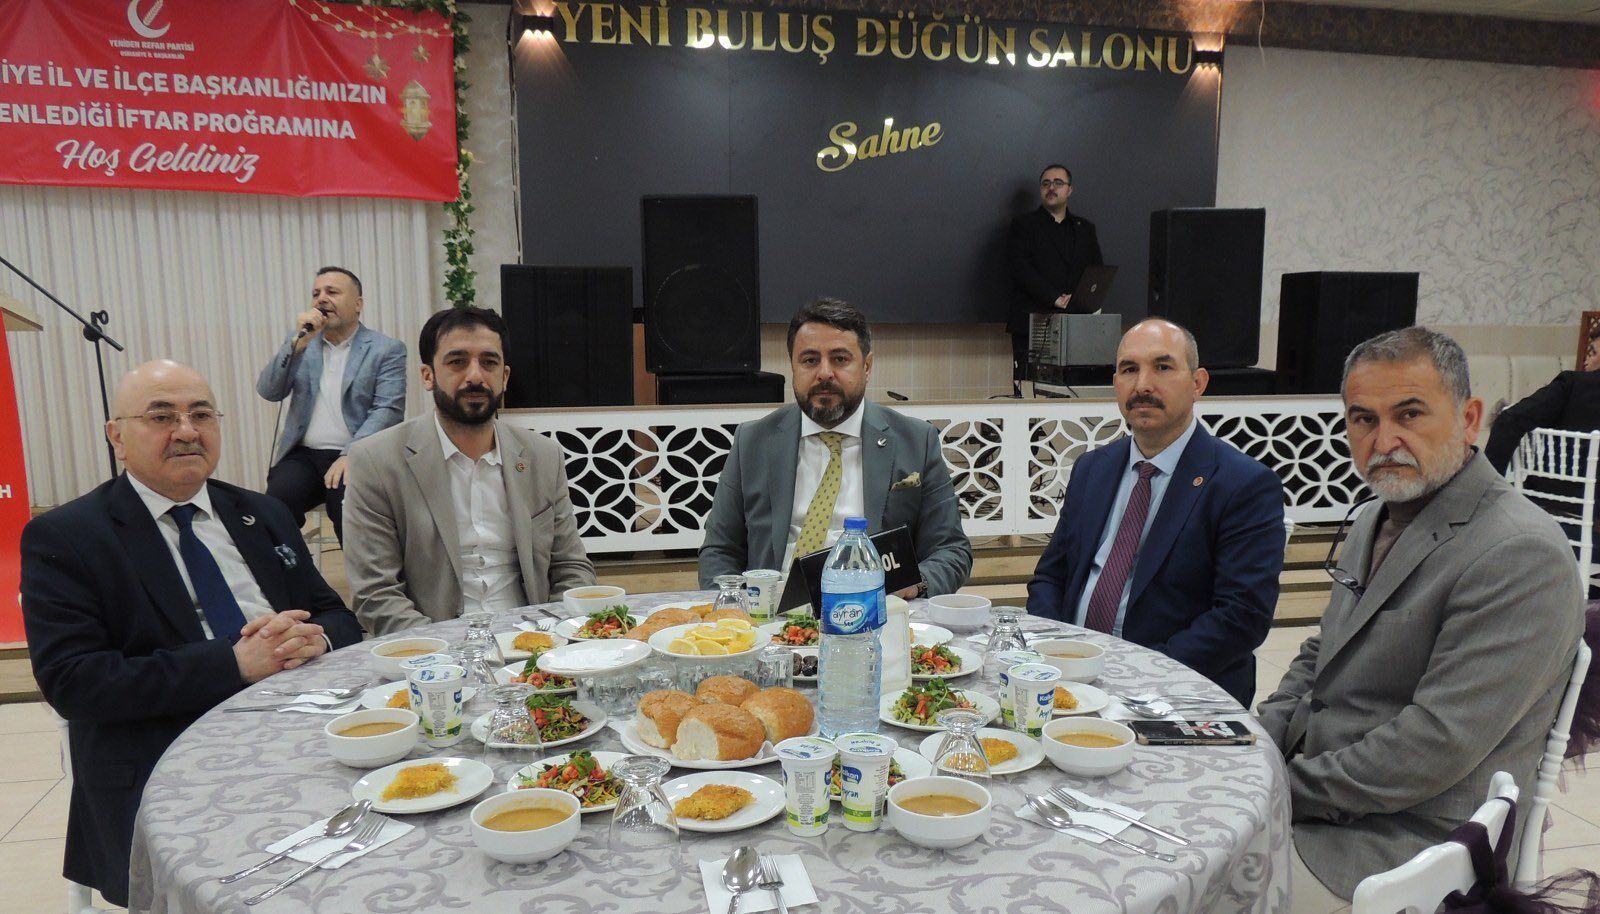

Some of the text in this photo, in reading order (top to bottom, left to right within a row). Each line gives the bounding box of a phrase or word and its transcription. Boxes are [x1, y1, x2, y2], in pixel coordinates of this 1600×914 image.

[556, 0, 1194, 75] YENİ BULUŞ DÜĞÜN SALONU
[47, 61, 72, 87] İL
[74, 67, 109, 89] VE
[113, 64, 170, 96] İLÇE
[173, 72, 387, 104] BAŞKANLIĞIMIZIN
[117, 103, 190, 132] İFTAR
[193, 108, 357, 140] PROĞRAMINA
[55, 139, 260, 184] Hoş Geldiniz
[816, 117, 945, 173] Sahne
